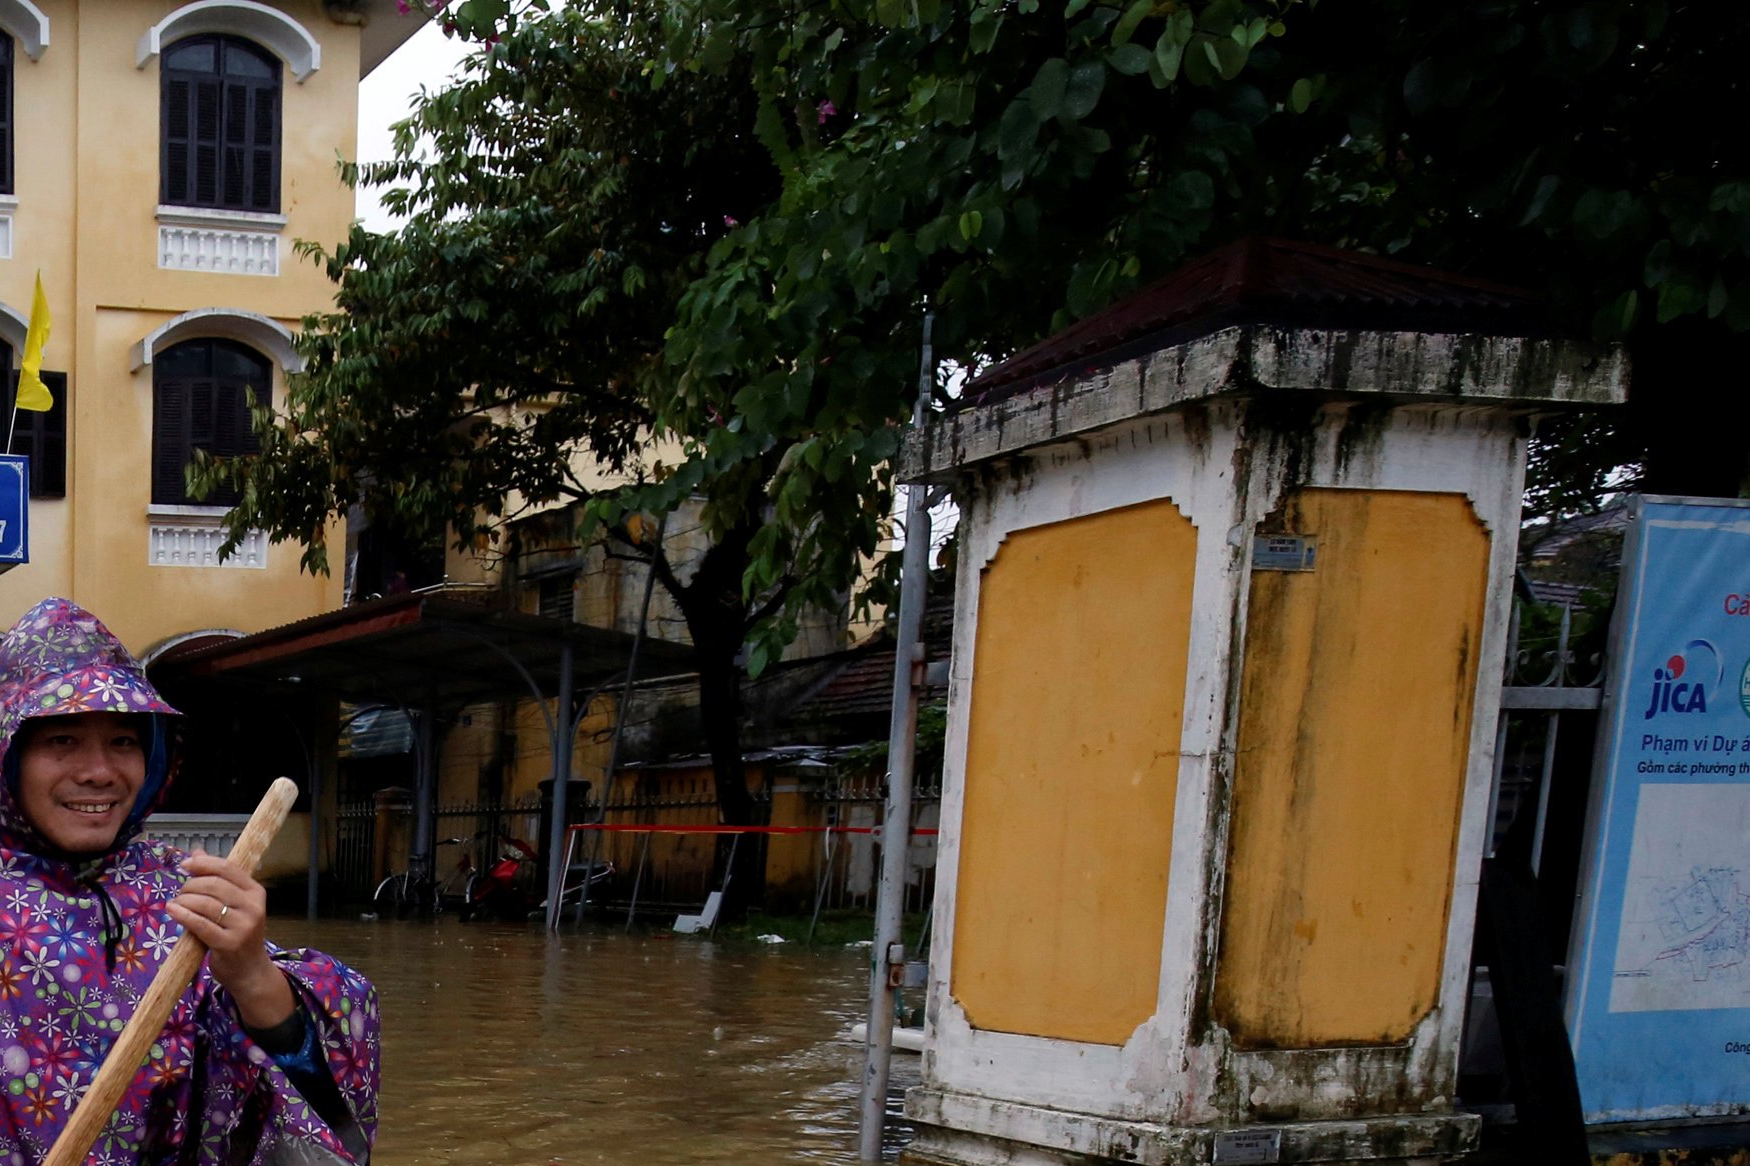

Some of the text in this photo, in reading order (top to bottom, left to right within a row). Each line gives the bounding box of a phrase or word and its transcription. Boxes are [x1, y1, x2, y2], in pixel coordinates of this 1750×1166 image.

[1641, 734, 1688, 755] Phạm
[1694, 735, 1708, 752] vi
[1712, 735, 1738, 756] Dự
[1667, 762, 1687, 774] các
